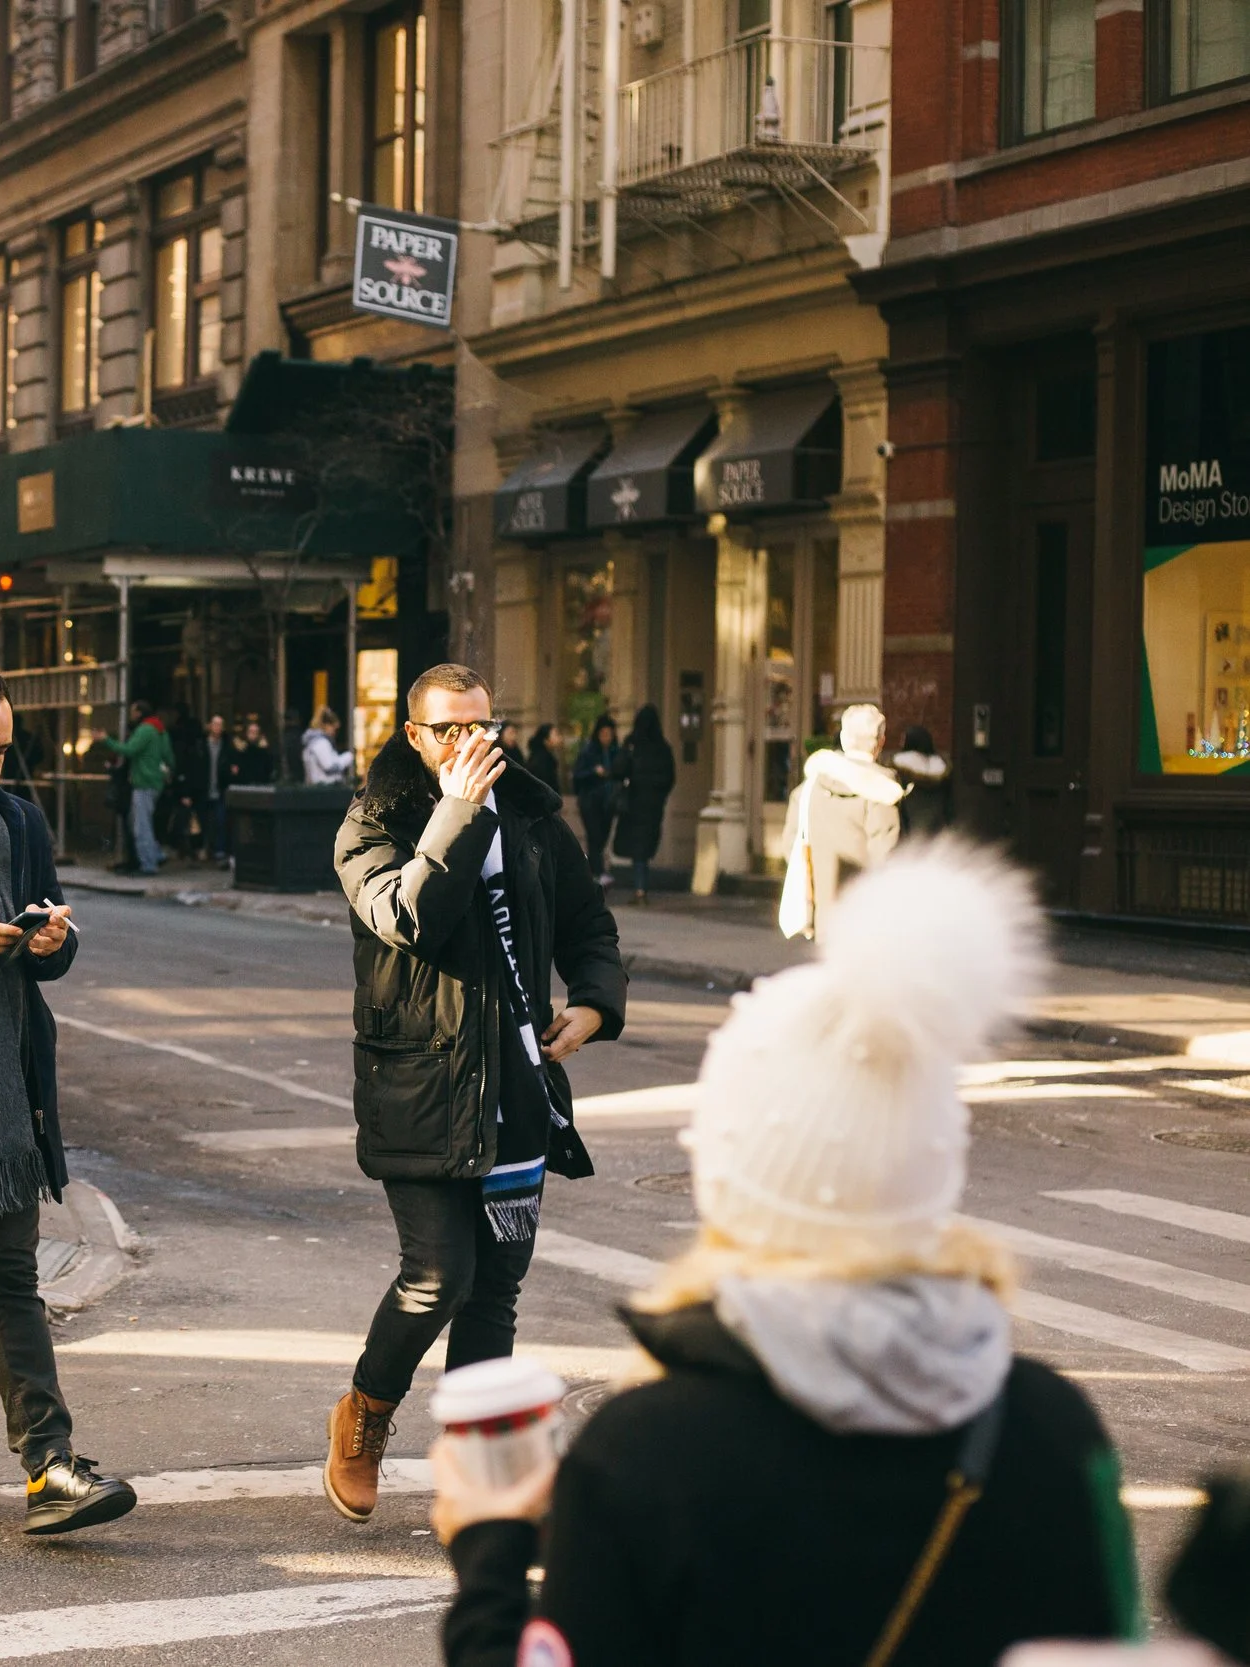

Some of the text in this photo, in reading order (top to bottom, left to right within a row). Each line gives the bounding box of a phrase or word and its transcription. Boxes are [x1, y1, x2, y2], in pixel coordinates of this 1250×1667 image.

[370, 225, 443, 262] PAPER
[360, 277, 447, 317] SOURCE
[1160, 459, 1222, 493] MoMA
[1159, 490, 1250, 526] Design Sto
